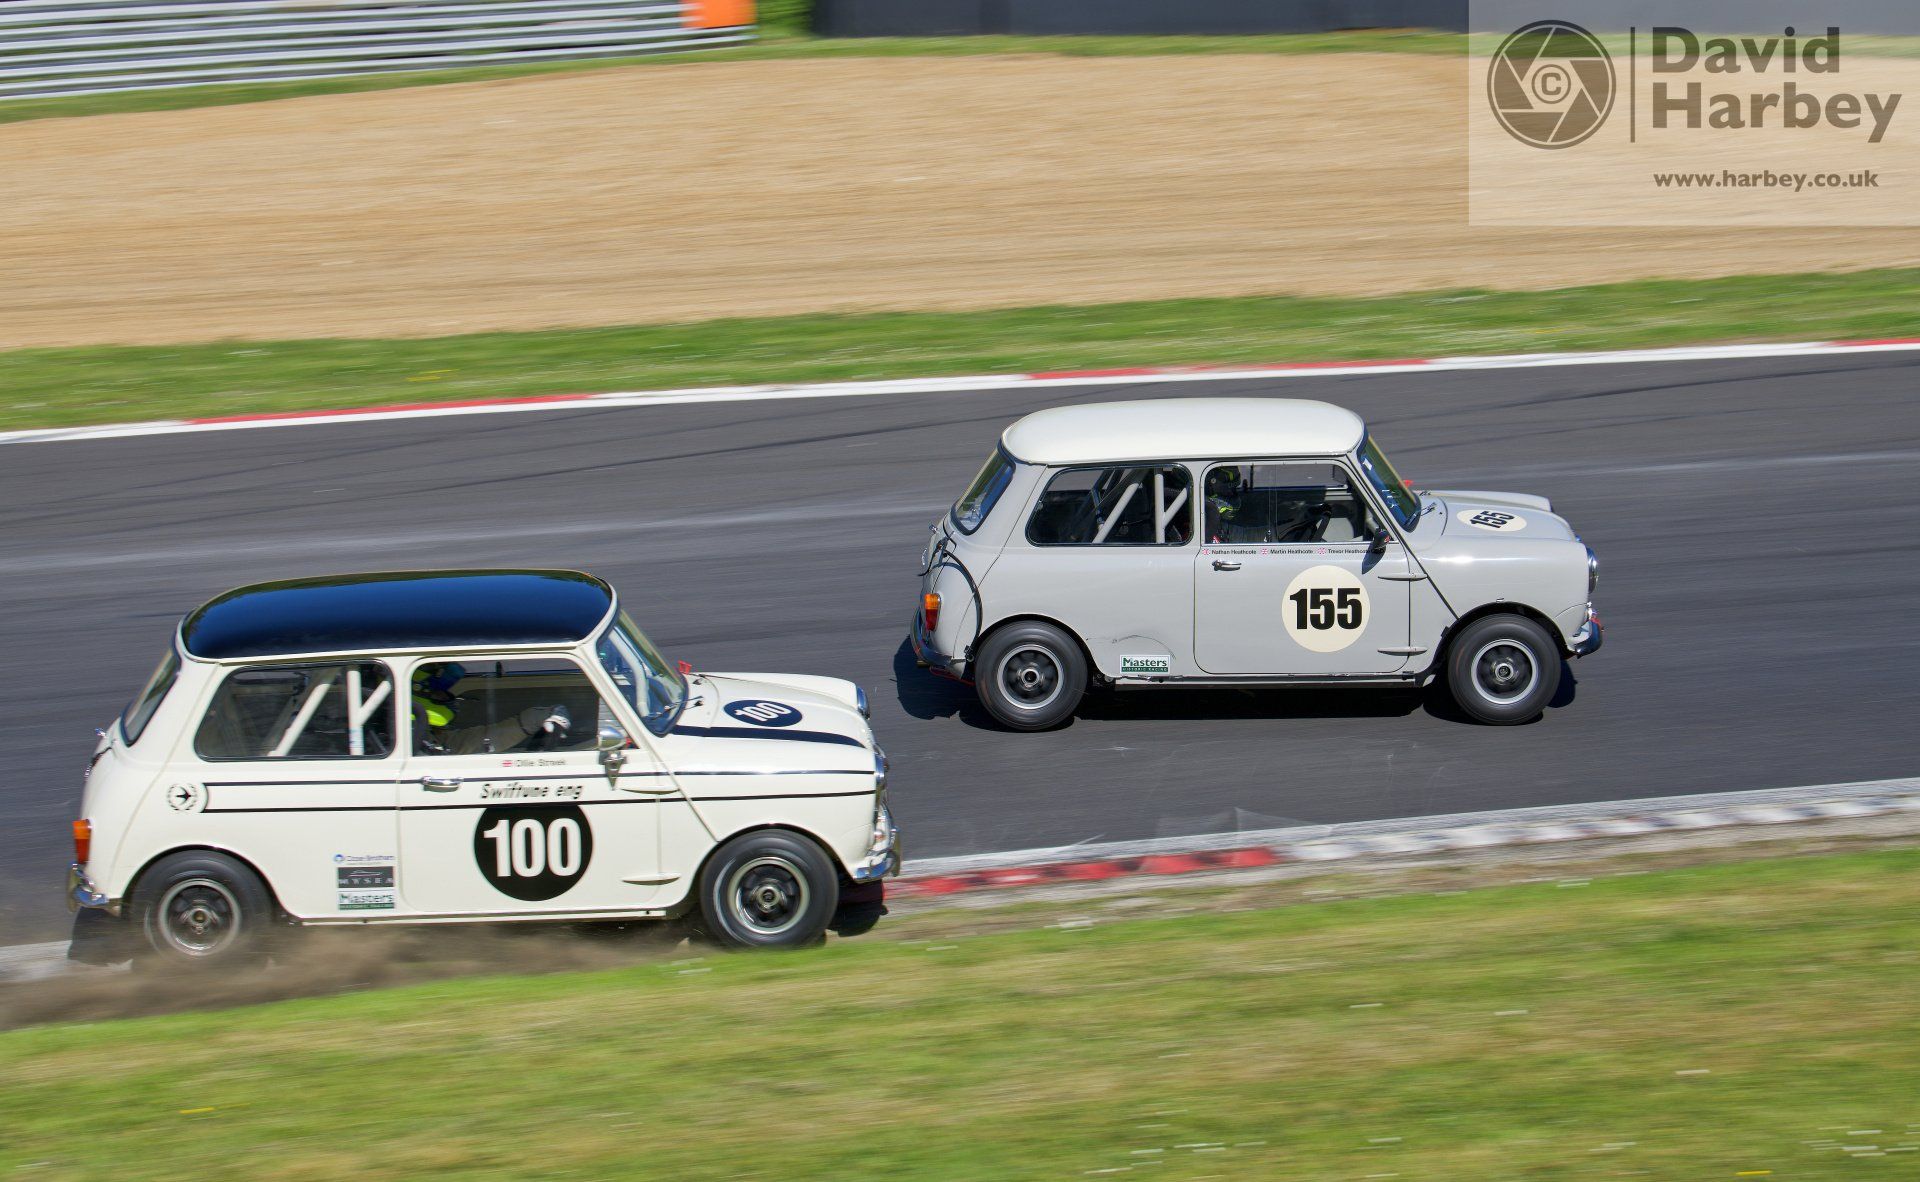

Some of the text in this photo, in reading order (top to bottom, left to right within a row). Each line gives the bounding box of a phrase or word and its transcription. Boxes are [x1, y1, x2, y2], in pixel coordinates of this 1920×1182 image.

[1469, 510, 1515, 528] 155
[1289, 587, 1363, 631] 155
[1123, 657, 1167, 667] Masters
[734, 702, 792, 721] 100
[555, 784, 584, 800] eng
[483, 817, 582, 878] 100
[339, 894, 394, 904] Masters
